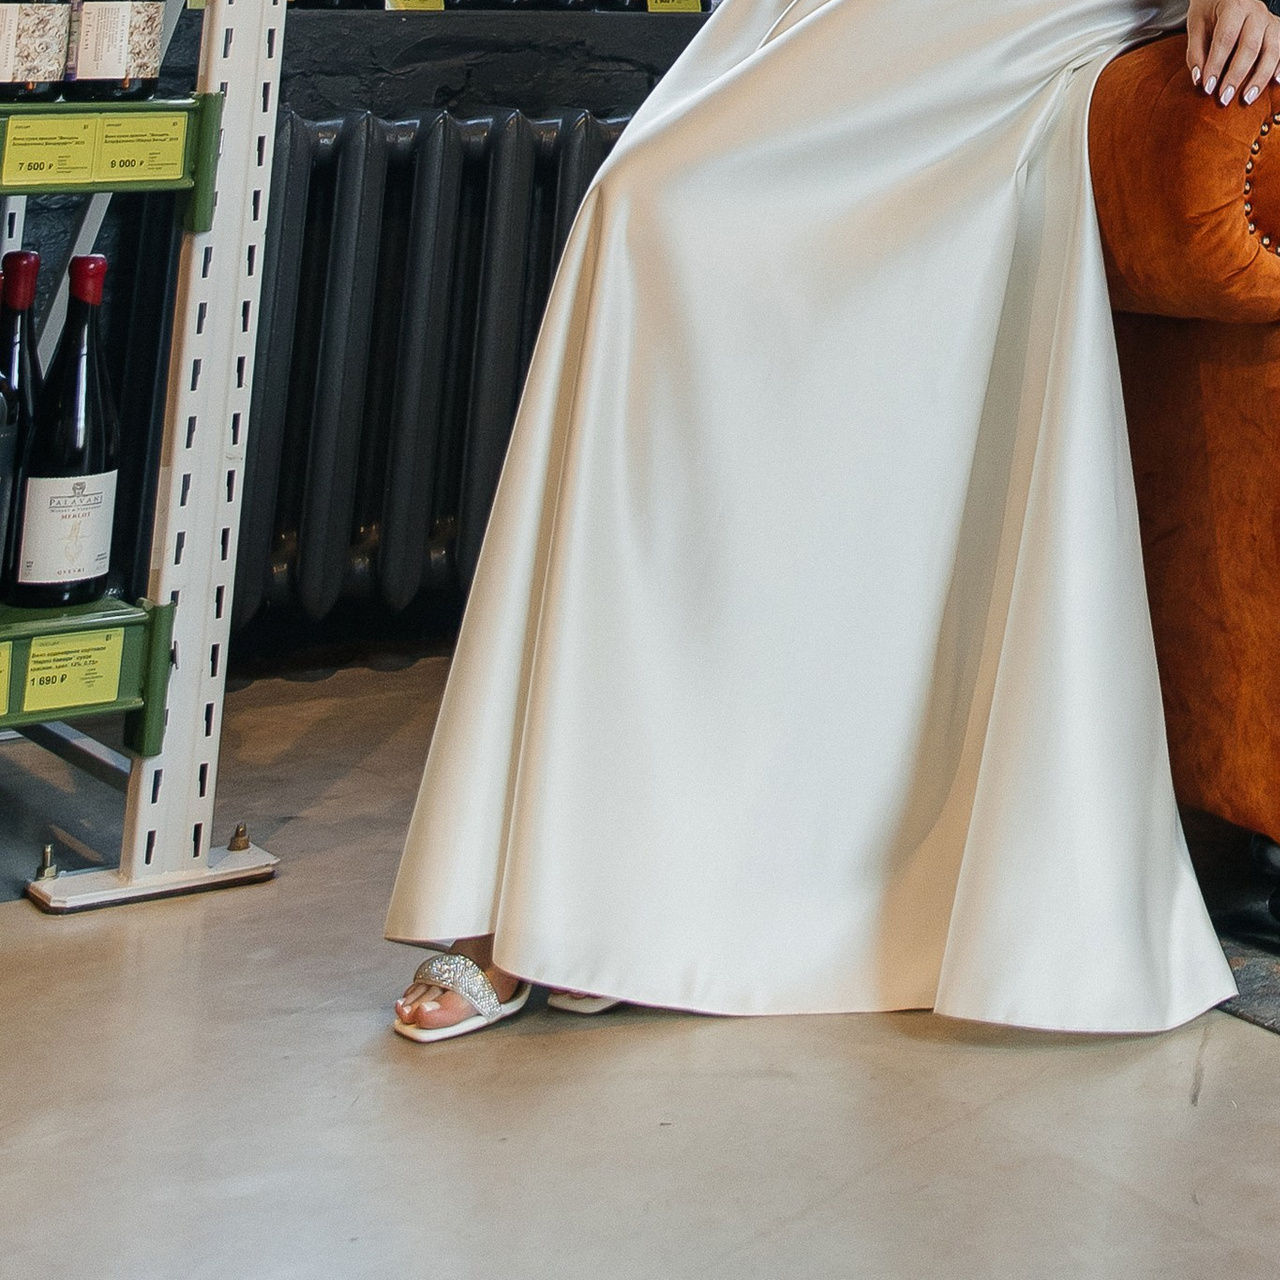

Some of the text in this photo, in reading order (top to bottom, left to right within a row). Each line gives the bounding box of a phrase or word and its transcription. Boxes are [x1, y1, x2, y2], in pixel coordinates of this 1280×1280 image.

[27, 161, 45, 171] 500
[119, 159, 136, 168] 000
[61, 512, 91, 520] MERLOT
[39, 675, 57, 686] 690
[61, 674, 67, 683] ₽
